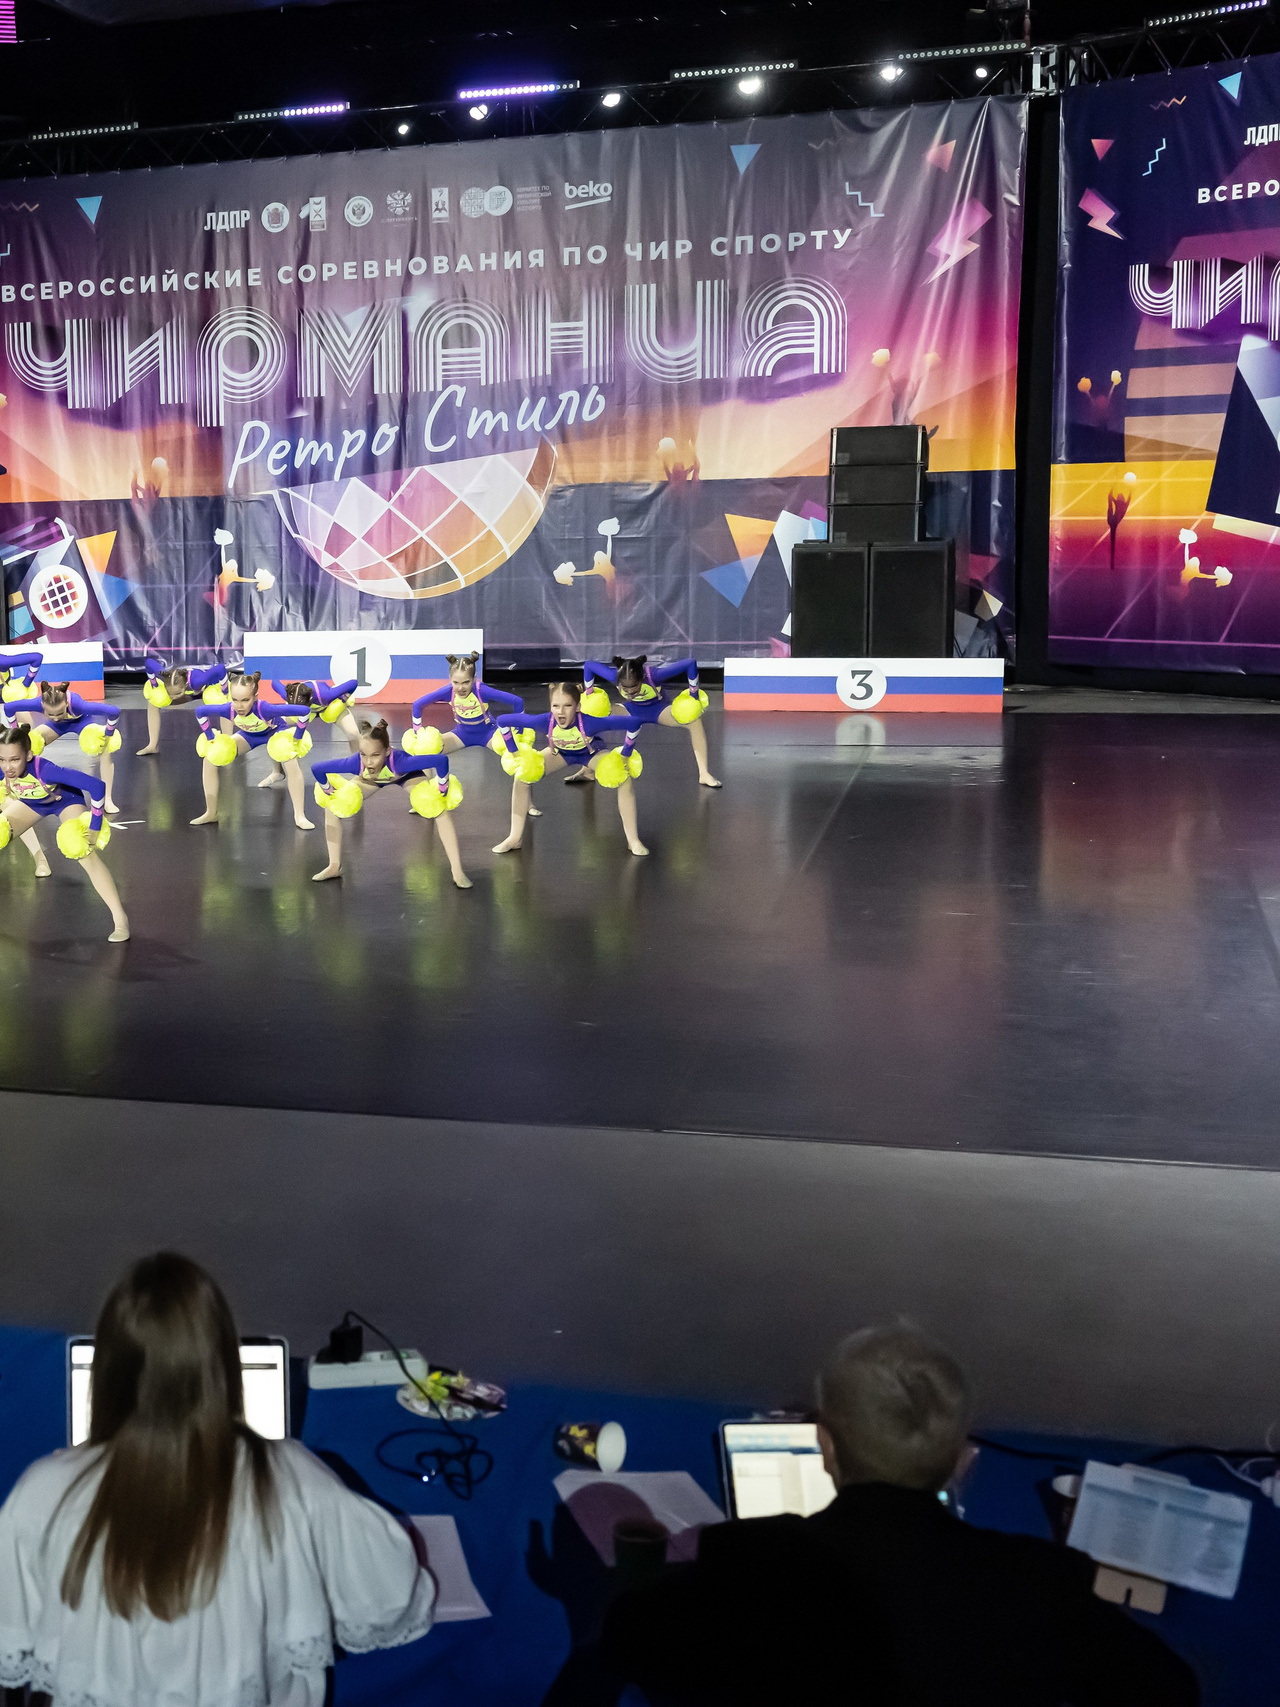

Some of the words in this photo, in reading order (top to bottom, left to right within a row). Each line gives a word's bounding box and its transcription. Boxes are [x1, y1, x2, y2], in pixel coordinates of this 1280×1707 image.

[1244, 124, 1280, 147] ЛДП
[564, 181, 613, 199] beko
[1198, 179, 1280, 204] ВСЕРО
[204, 209, 251, 232] ЛДПР
[1, 267, 262, 302] ВСЕРОССИЙСКИЕ
[277, 249, 545, 285] СОРЕВНОВАНИЯ
[563, 244, 608, 266] ПО
[625, 239, 693, 262] ЧИР
[710, 228, 852, 257] СПОРТУ
[1129, 252, 1280, 341] ЧИ
[228, 420, 400, 489] Ретро
[423, 384, 606, 453] Стиль
[349, 646, 372, 687] 1
[849, 669, 874, 701] 3
